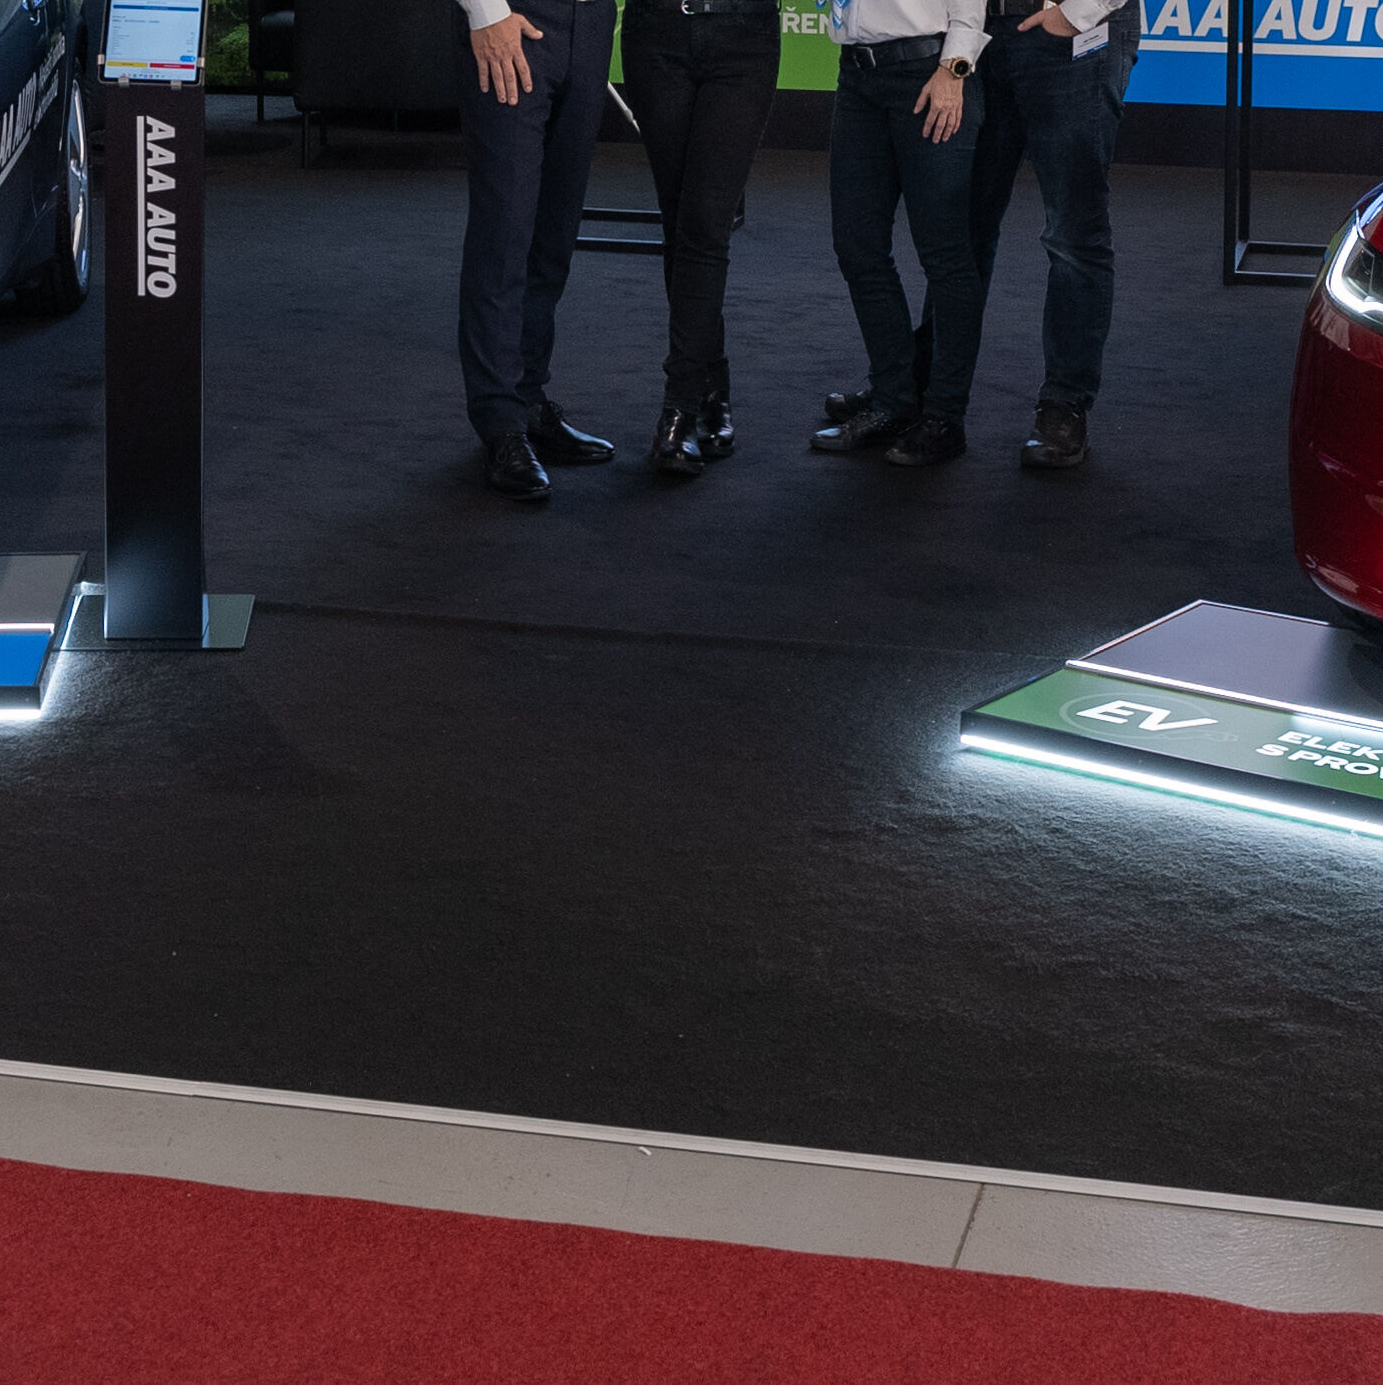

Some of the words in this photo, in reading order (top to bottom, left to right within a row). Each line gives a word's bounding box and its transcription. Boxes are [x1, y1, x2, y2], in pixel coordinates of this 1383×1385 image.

[147, 115, 176, 192] AAA
[147, 201, 177, 298] AUTO
[1076, 700, 1219, 733] EV
[1255, 744, 1285, 757] S
